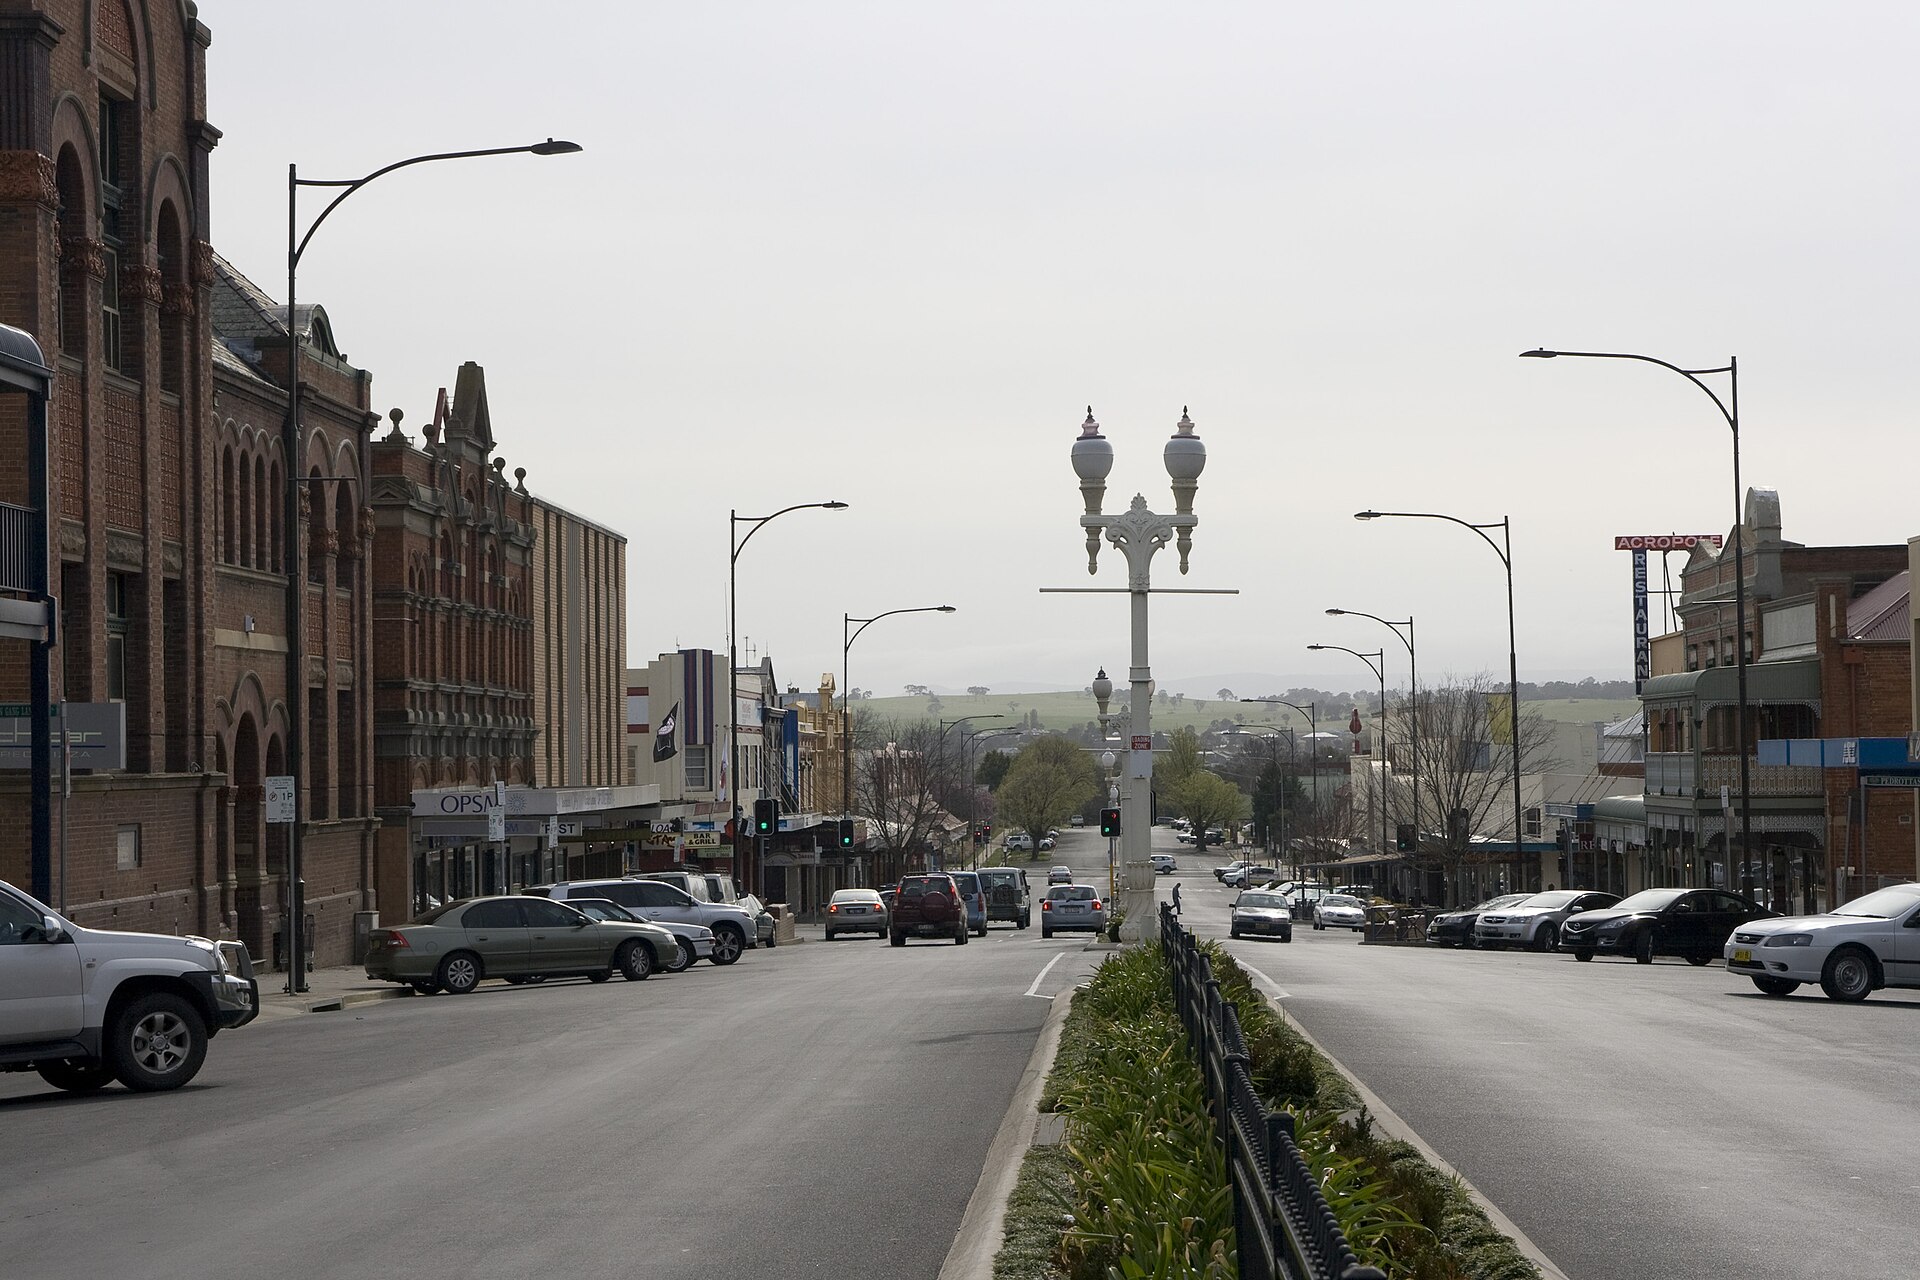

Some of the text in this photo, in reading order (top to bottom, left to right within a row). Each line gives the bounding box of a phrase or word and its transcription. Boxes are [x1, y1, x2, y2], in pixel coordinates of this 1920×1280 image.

[1616, 536, 1720, 549] ACROPOE
[1634, 553, 1648, 694] RESTAURANT
[441, 795, 500, 813] OPSM
